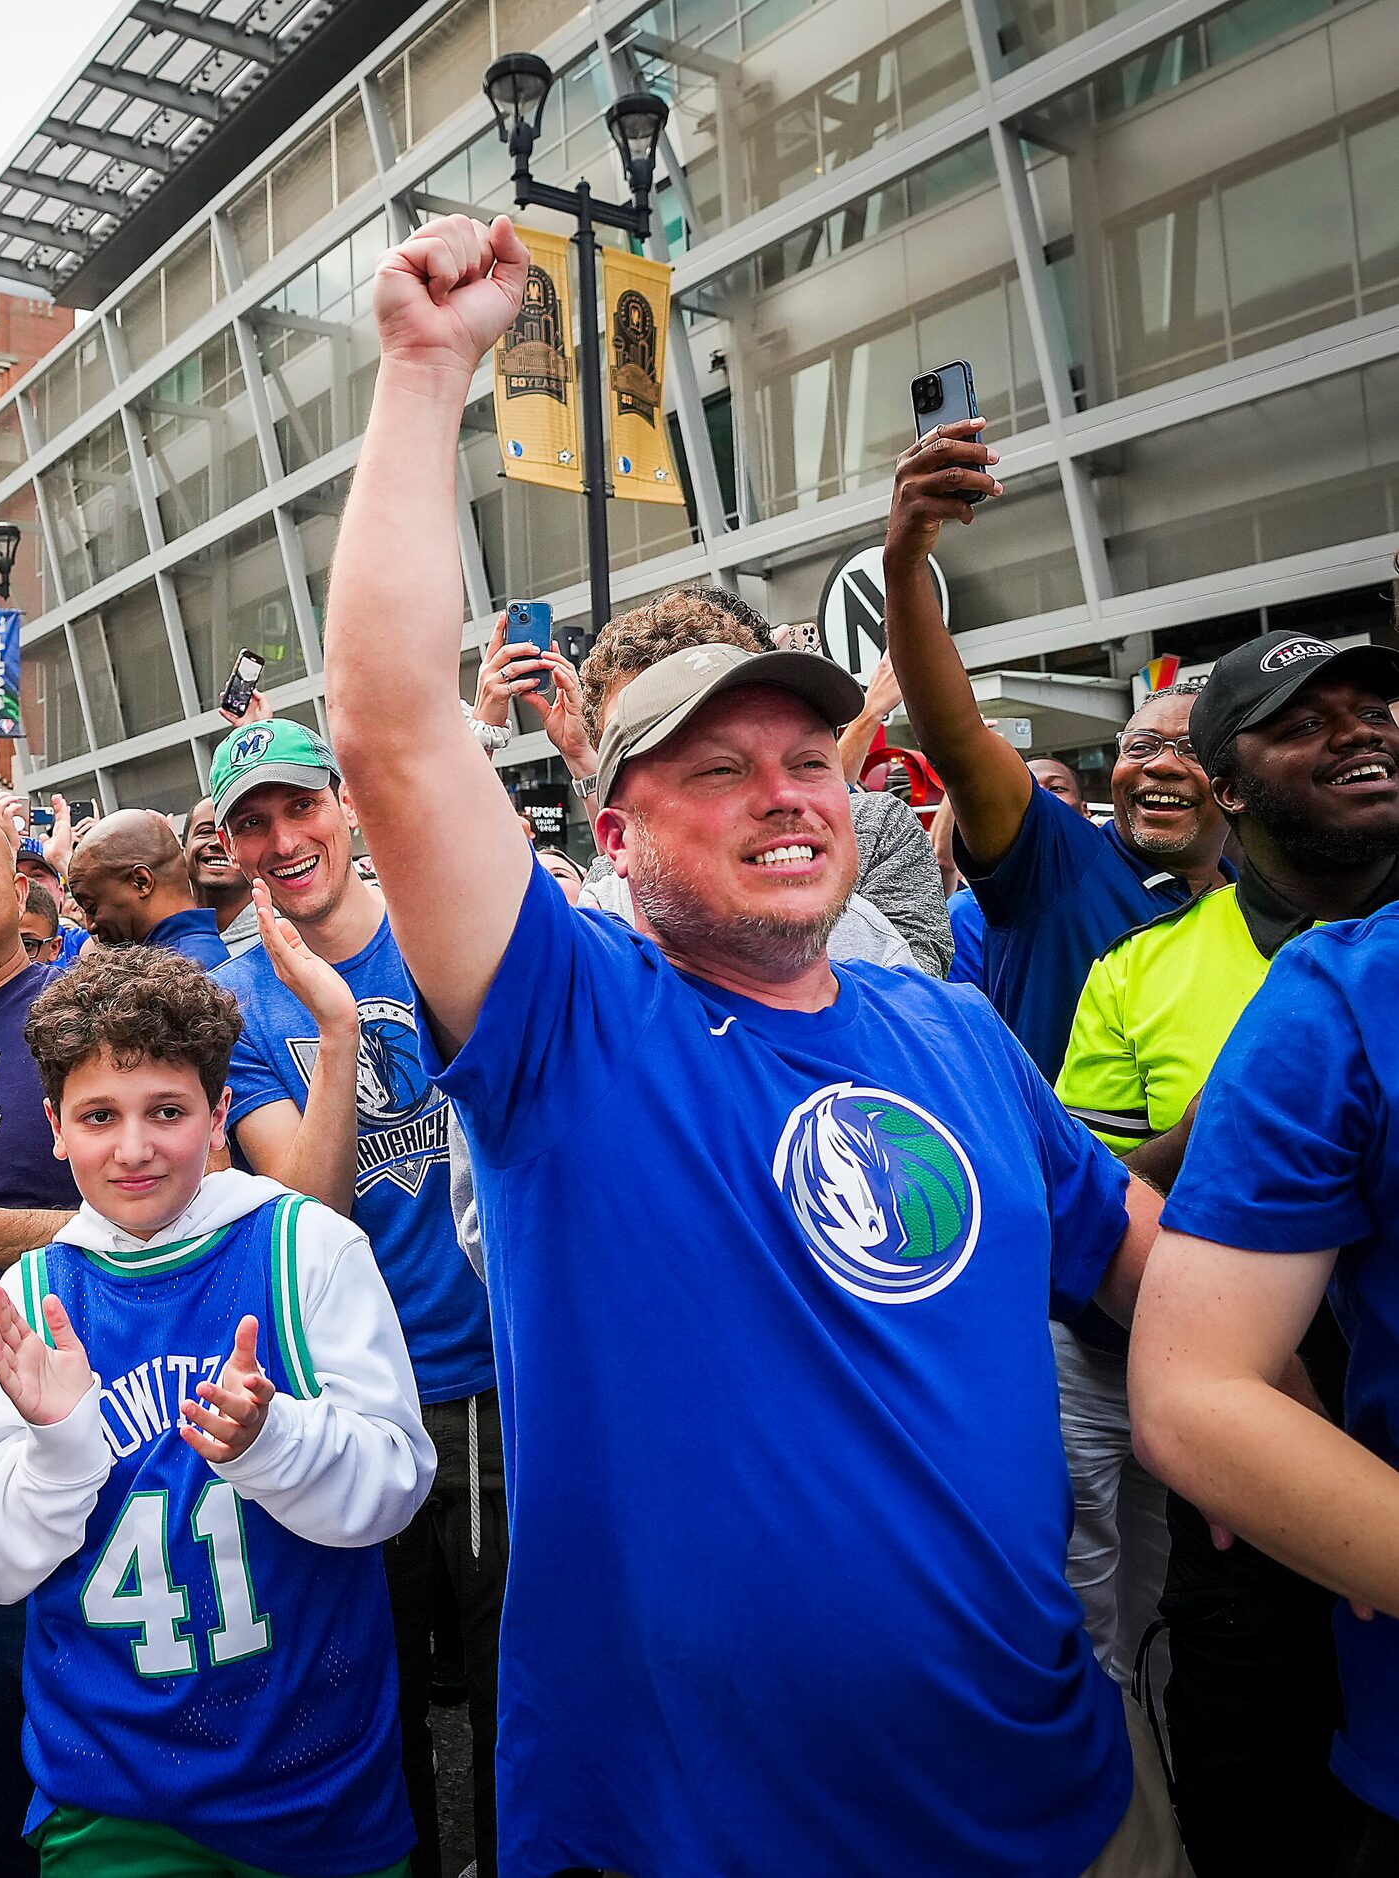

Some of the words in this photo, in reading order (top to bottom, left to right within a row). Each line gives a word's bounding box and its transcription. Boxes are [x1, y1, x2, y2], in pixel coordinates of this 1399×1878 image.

[231, 734, 265, 765] M
[357, 1006, 399, 1018] LLAS
[357, 1104, 450, 1175] AVERICK
[100, 1354, 224, 1466] OWITZ
[79, 1477, 274, 1679] 41
